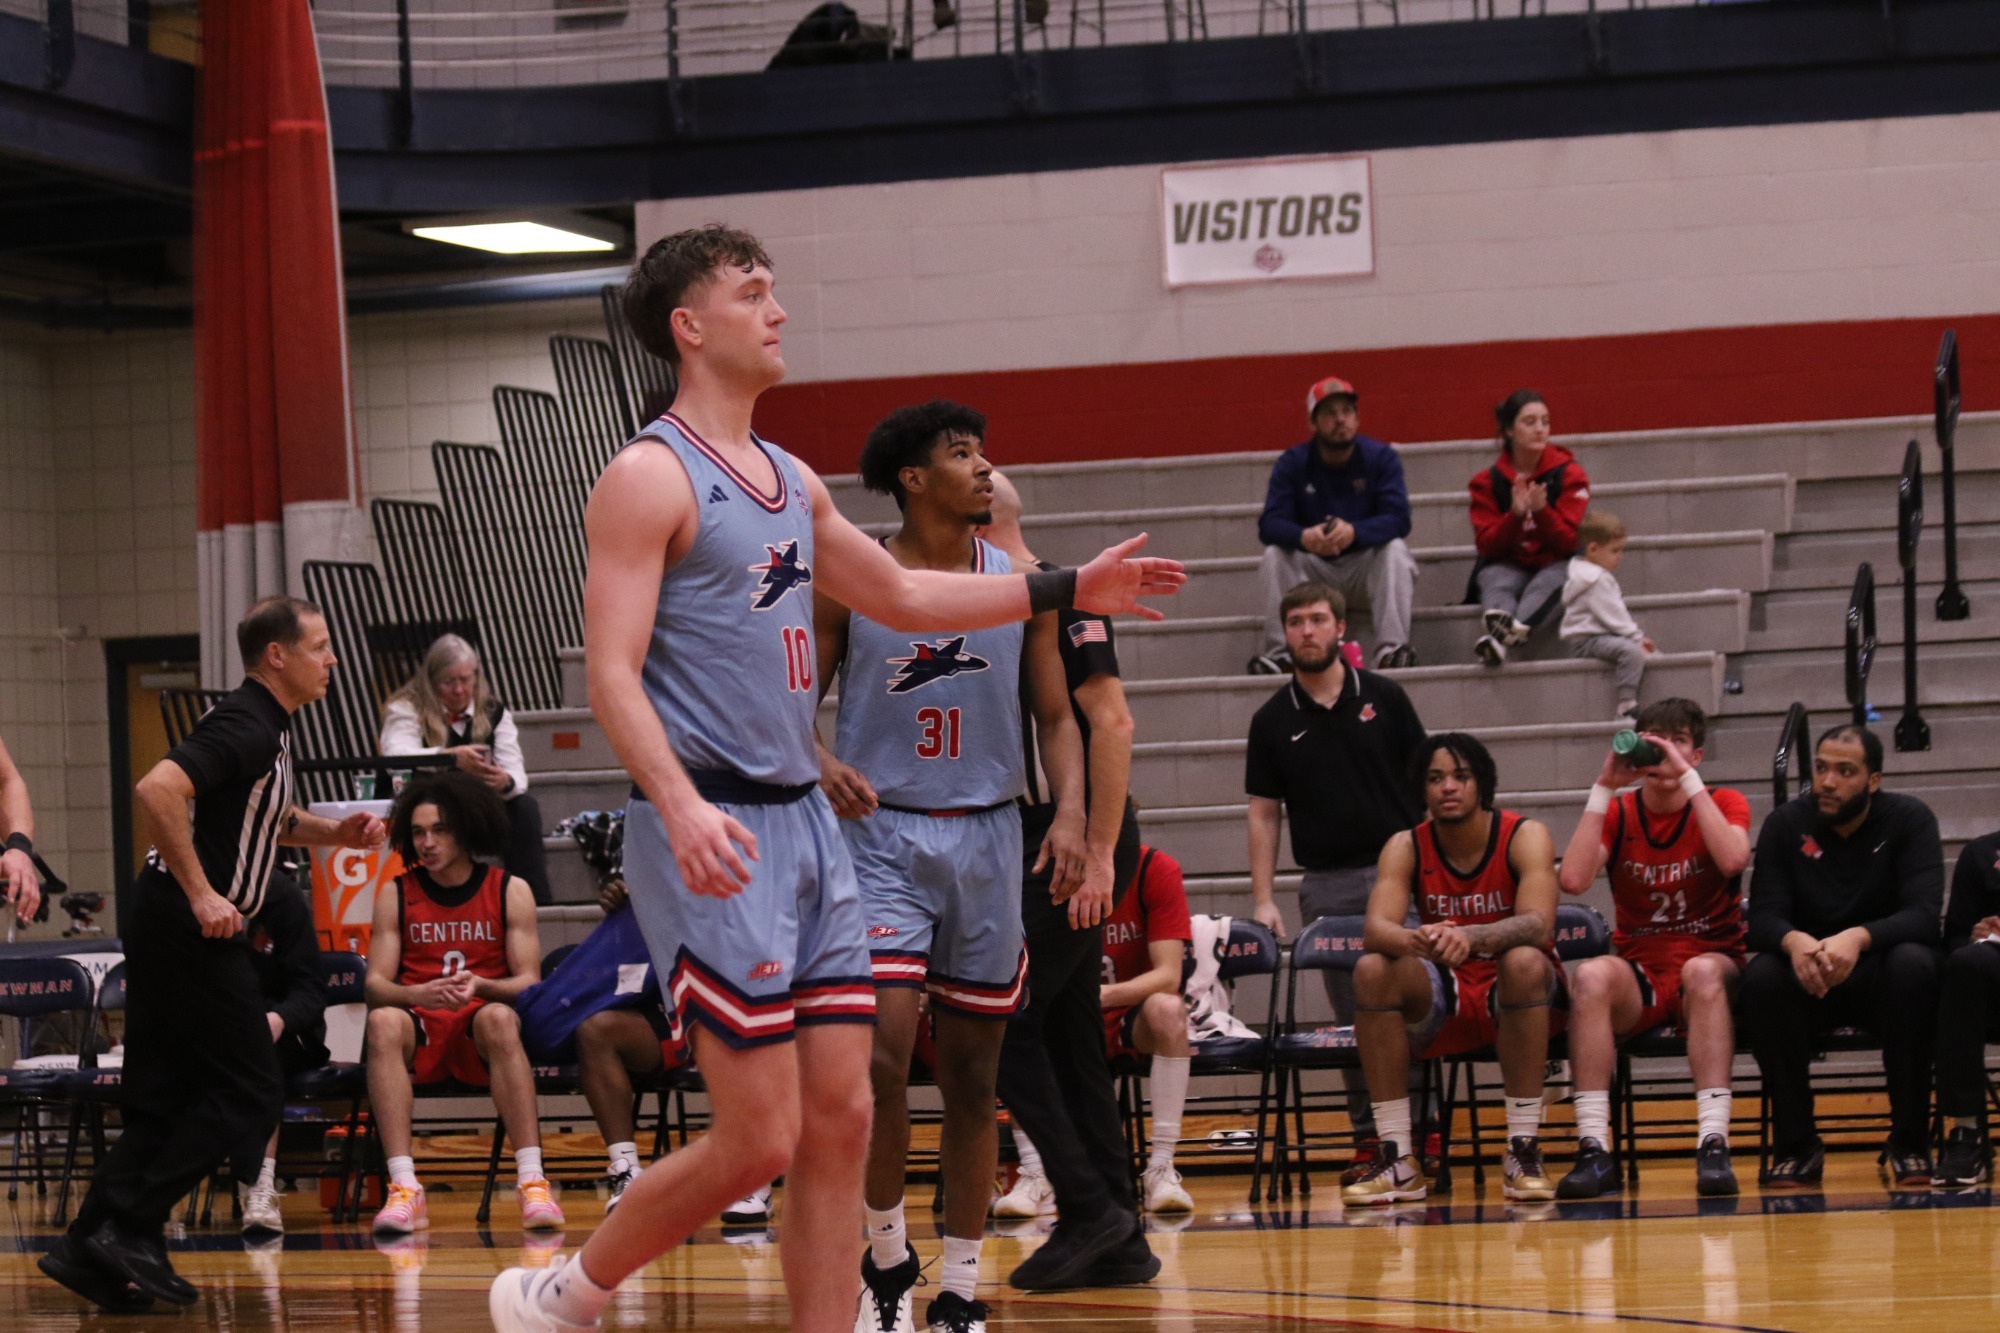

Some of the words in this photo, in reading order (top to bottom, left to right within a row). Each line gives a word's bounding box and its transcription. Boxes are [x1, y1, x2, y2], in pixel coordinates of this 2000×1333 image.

[1173, 192, 1363, 244] VISITORS
[782, 626, 812, 692] 10
[916, 707, 961, 758] 31
[333, 847, 368, 886] G
[1624, 856, 1705, 885] CENTRAL
[1426, 890, 1513, 917] CENTRAL
[1650, 889, 1688, 923] 21
[409, 920, 496, 944] CENTRAL
[1314, 937, 1366, 951] NEW
[0, 979, 73, 996] EWMAN
[93, 1074, 121, 1085] JET
